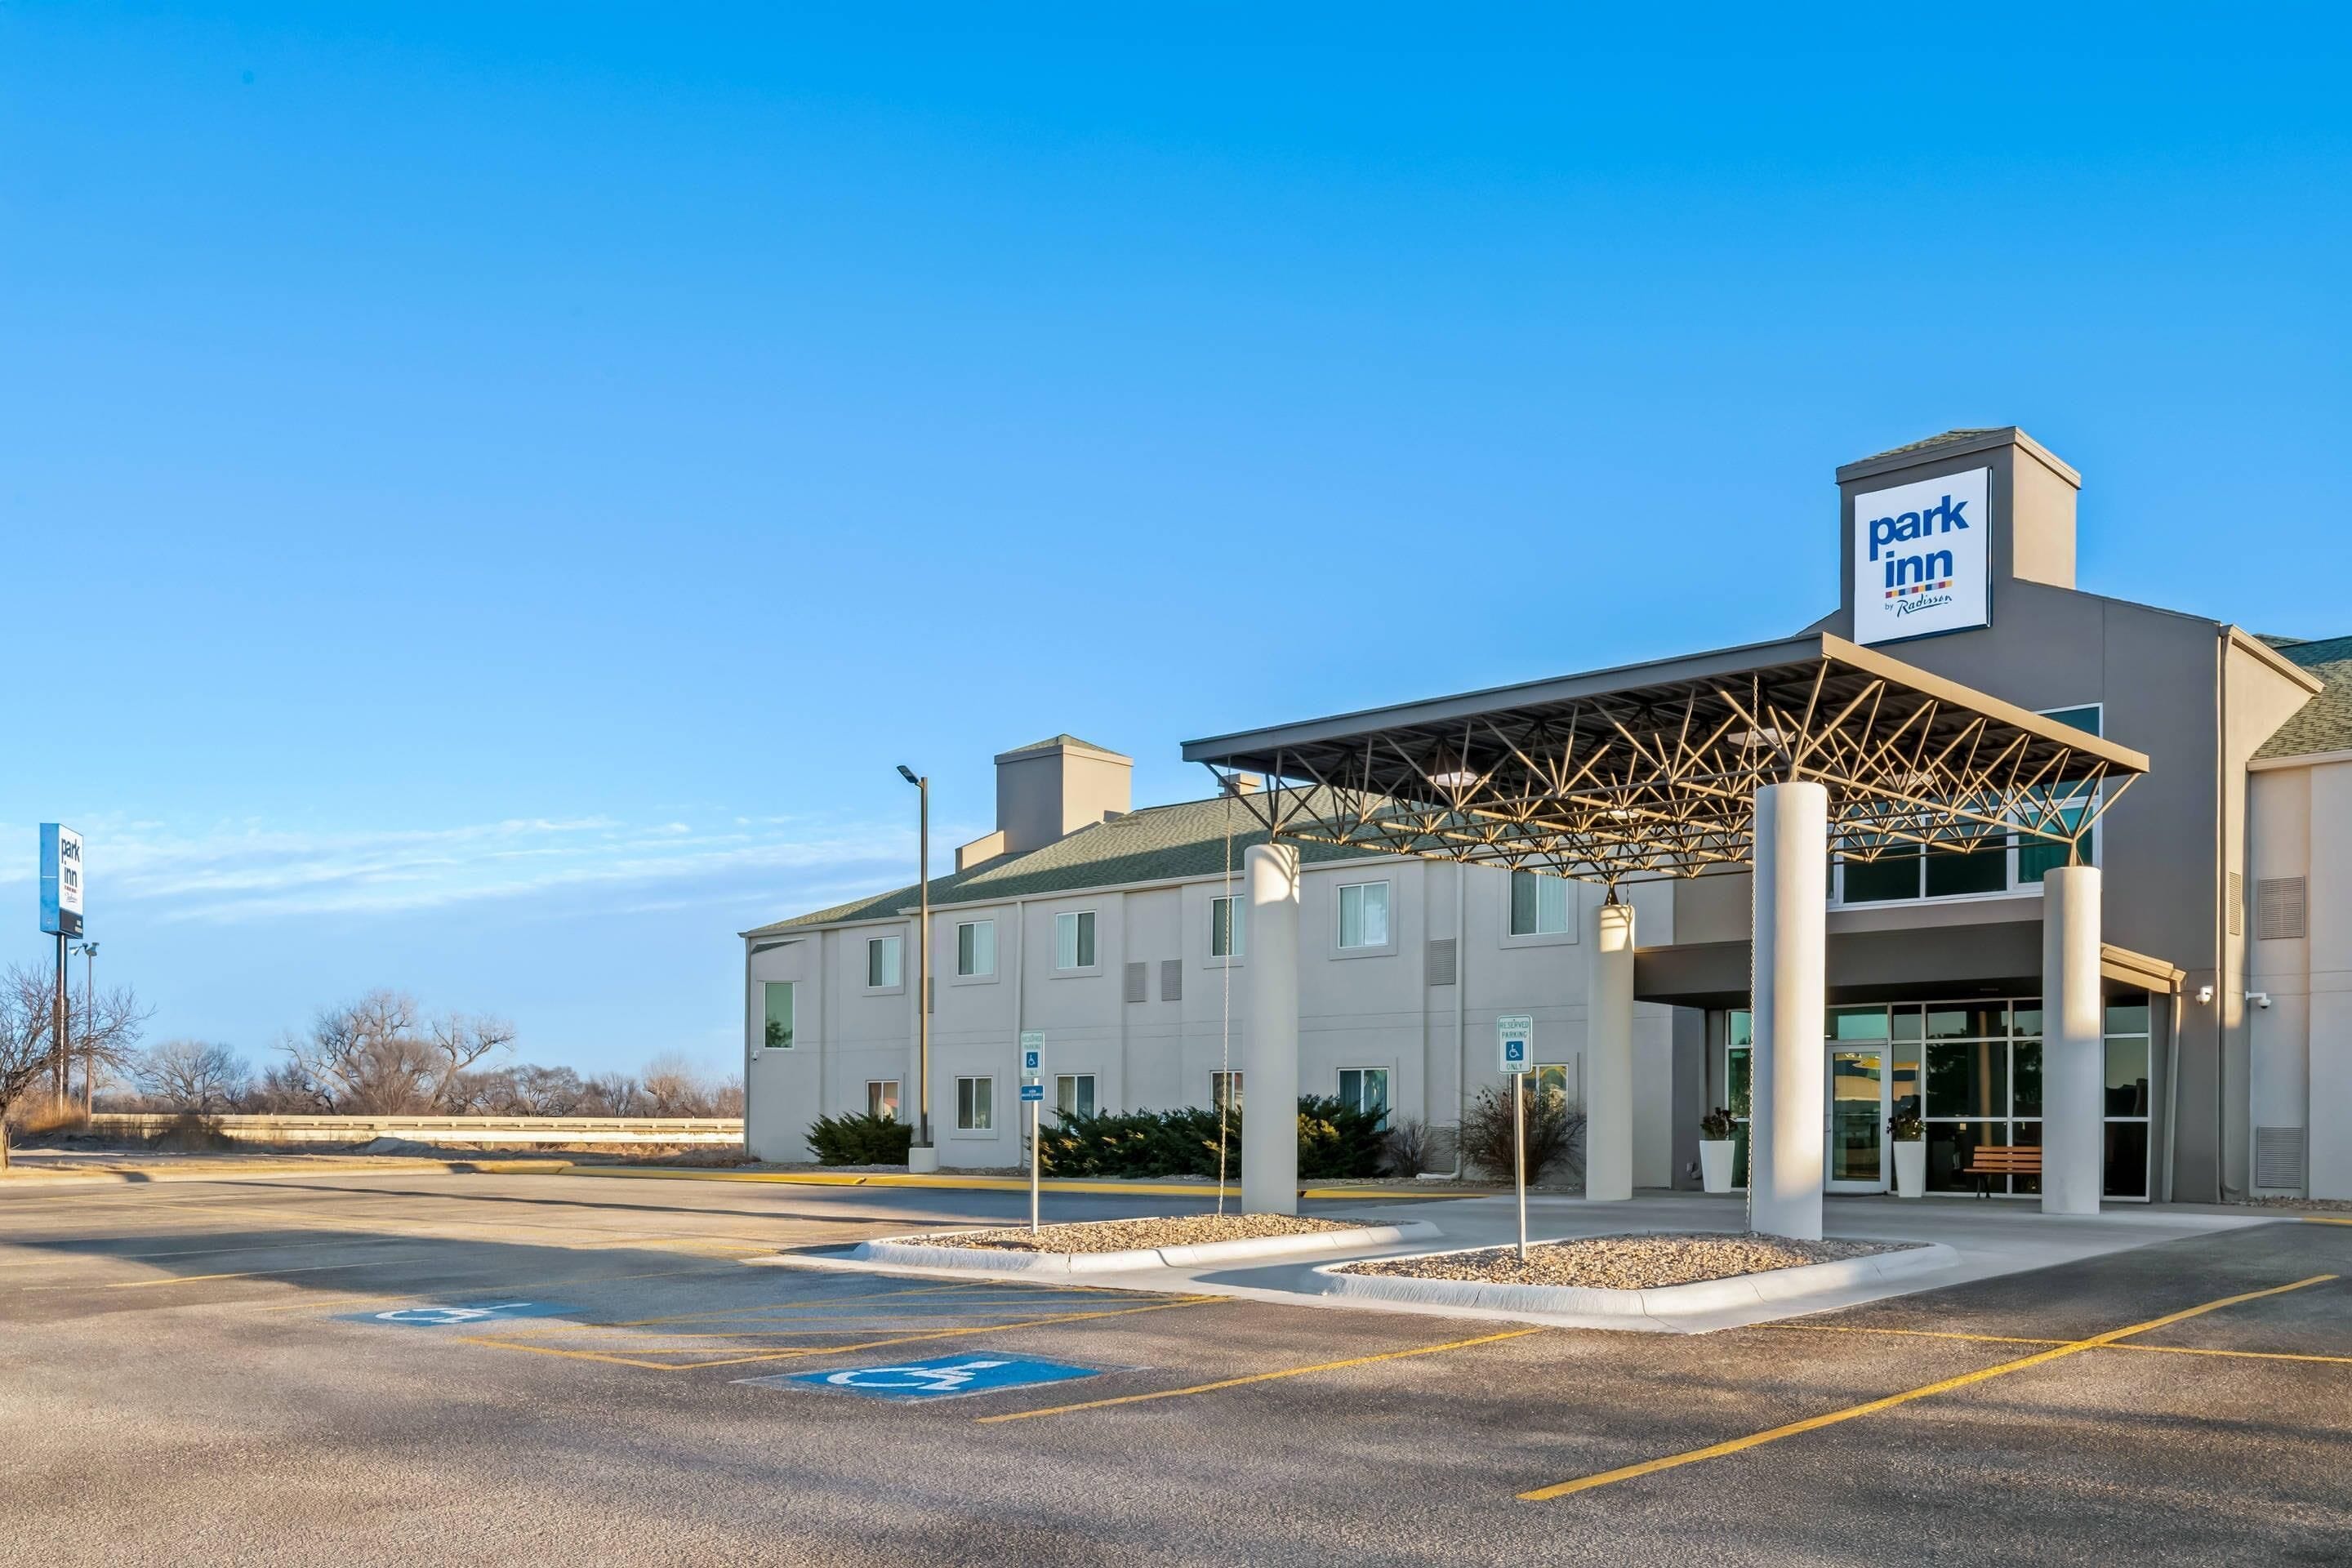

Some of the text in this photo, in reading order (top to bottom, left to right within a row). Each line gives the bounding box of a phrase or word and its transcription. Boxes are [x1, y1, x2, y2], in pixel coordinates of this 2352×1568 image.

[1869, 495, 1970, 562] park
[1886, 550, 1953, 588] inn
[1885, 593, 1953, 617] by Radisson
[61, 837, 80, 864] park
[64, 860, 78, 888] inn
[1502, 1031, 1527, 1039] PARKING
